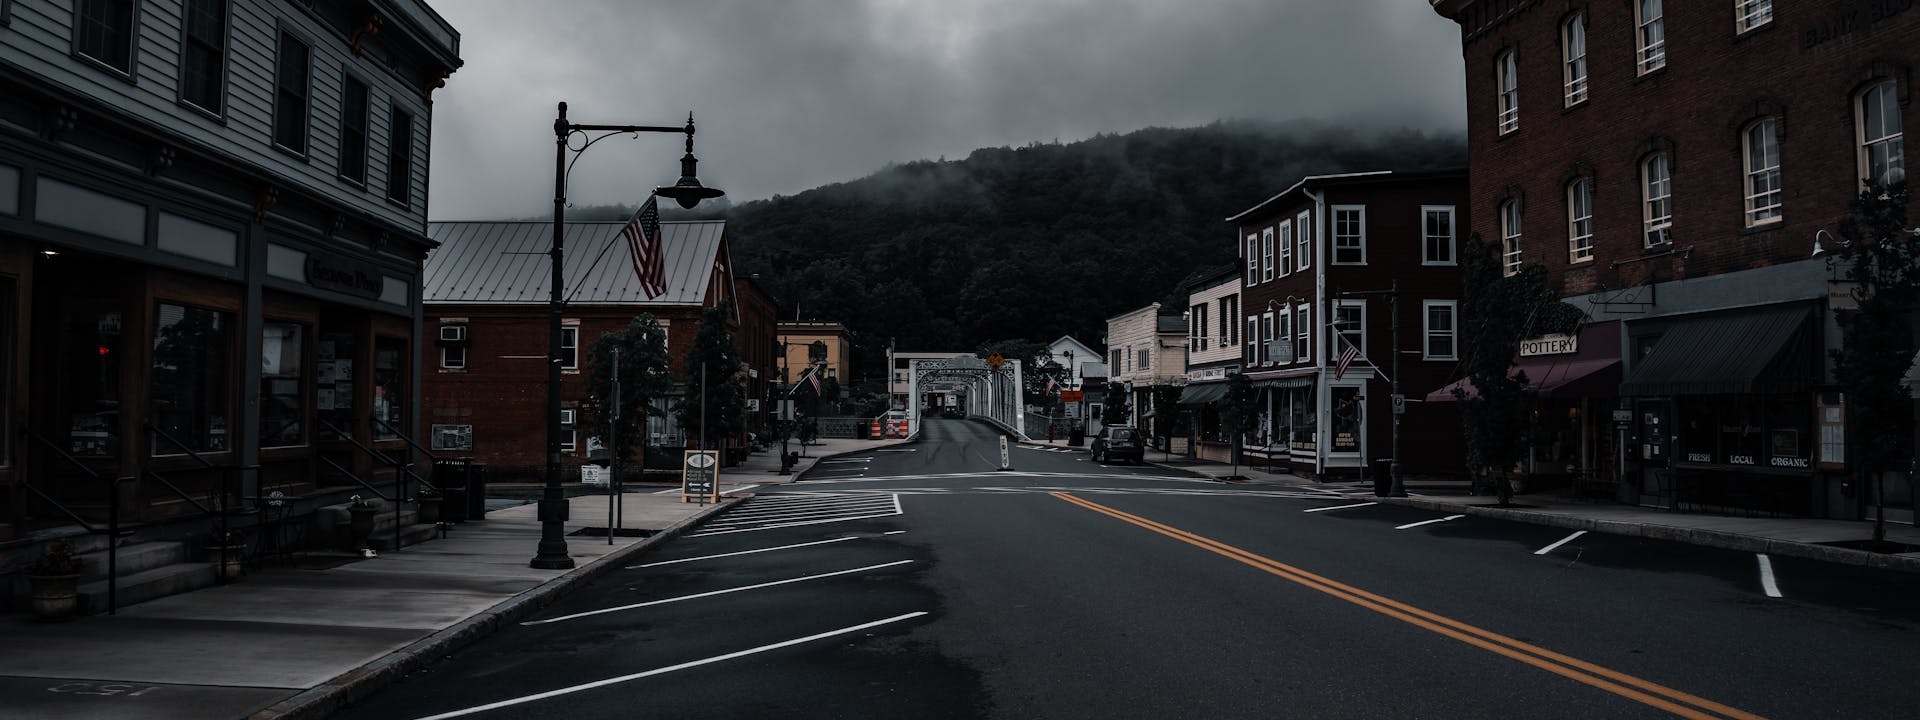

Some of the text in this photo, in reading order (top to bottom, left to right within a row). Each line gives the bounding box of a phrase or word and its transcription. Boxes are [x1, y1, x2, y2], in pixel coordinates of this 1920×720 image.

[1522, 339, 1576, 354] POTTERY
[1688, 453, 1711, 463] FRESH
[1730, 455, 1754, 465] LOCAL
[1771, 457, 1808, 468] ORGANIC
